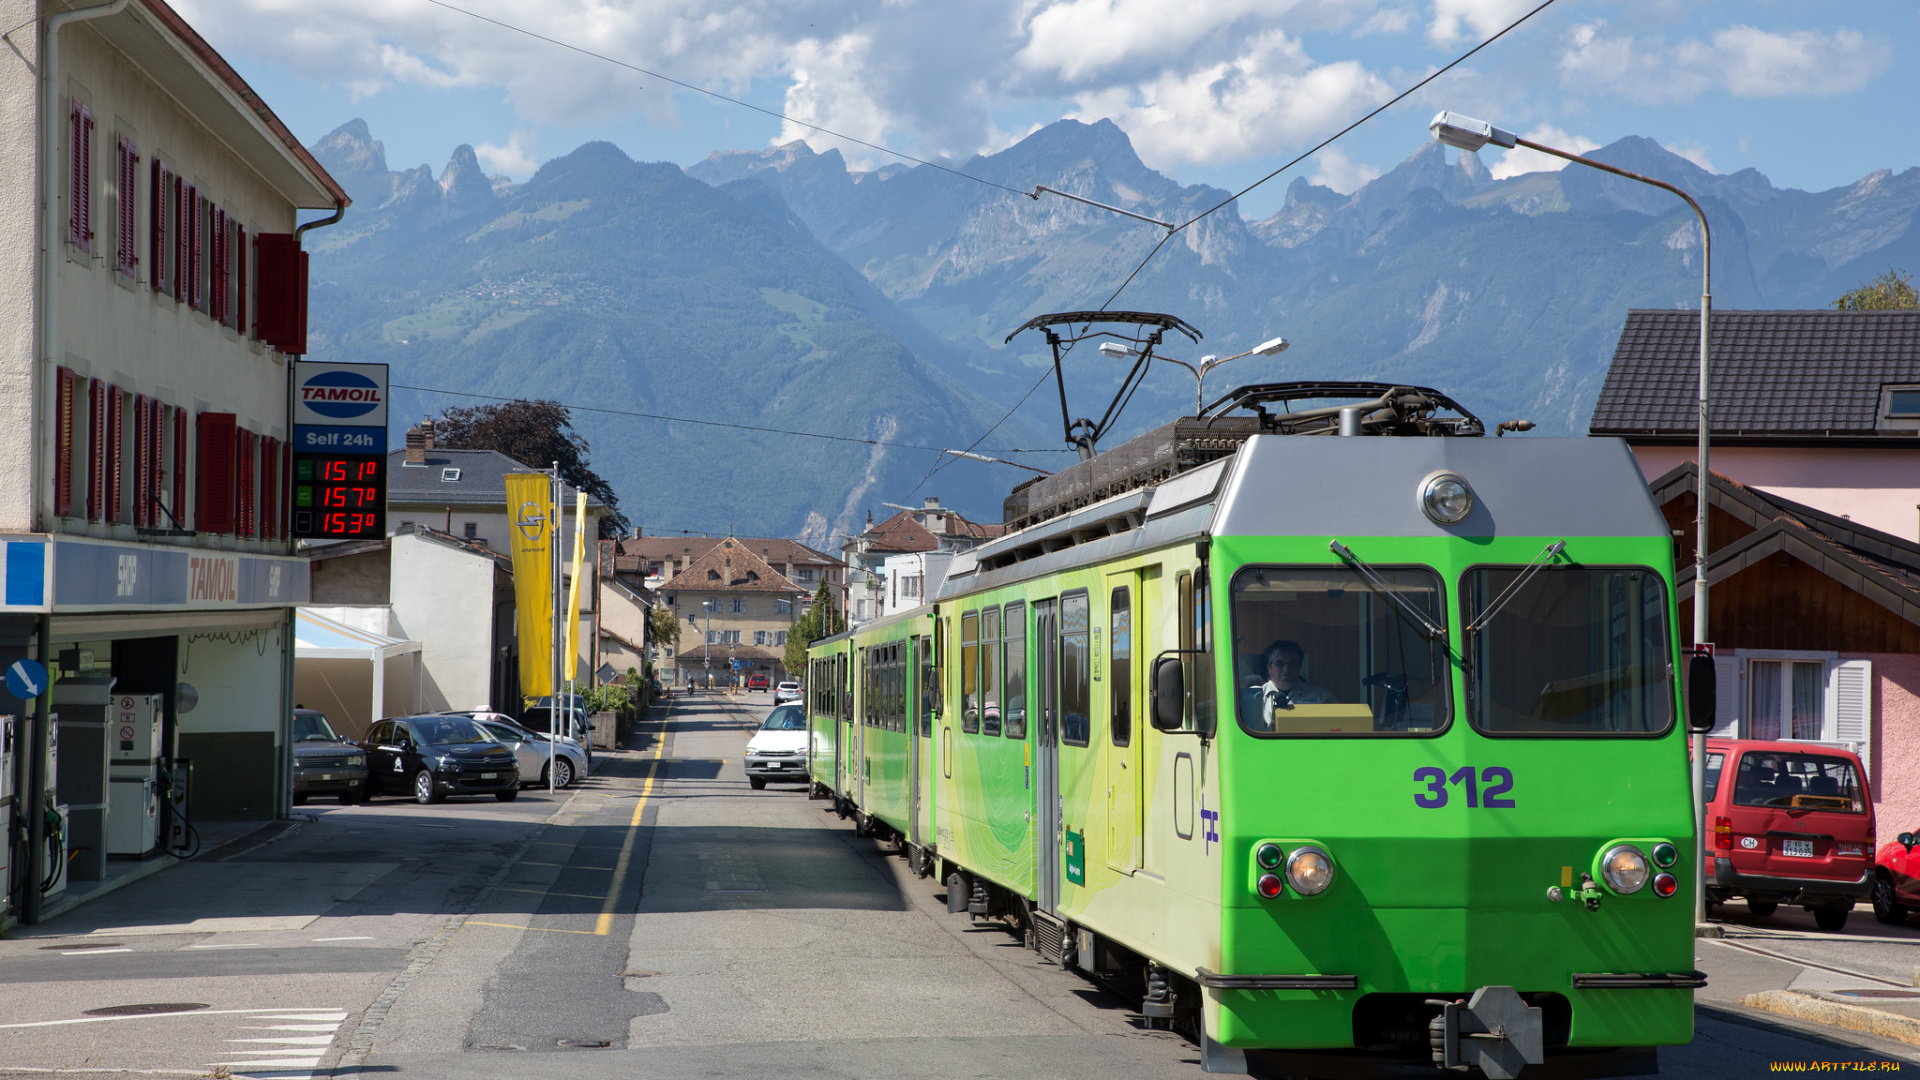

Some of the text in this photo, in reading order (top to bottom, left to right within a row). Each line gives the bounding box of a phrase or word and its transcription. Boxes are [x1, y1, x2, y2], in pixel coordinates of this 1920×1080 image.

[301, 387, 381, 402] TAMOIL
[306, 432, 374, 446] Self 24h
[117, 554, 137, 597] SHOP
[190, 557, 236, 602] TAMOIL
[1413, 766, 1516, 809] 312
[1743, 838, 1755, 848] CH
